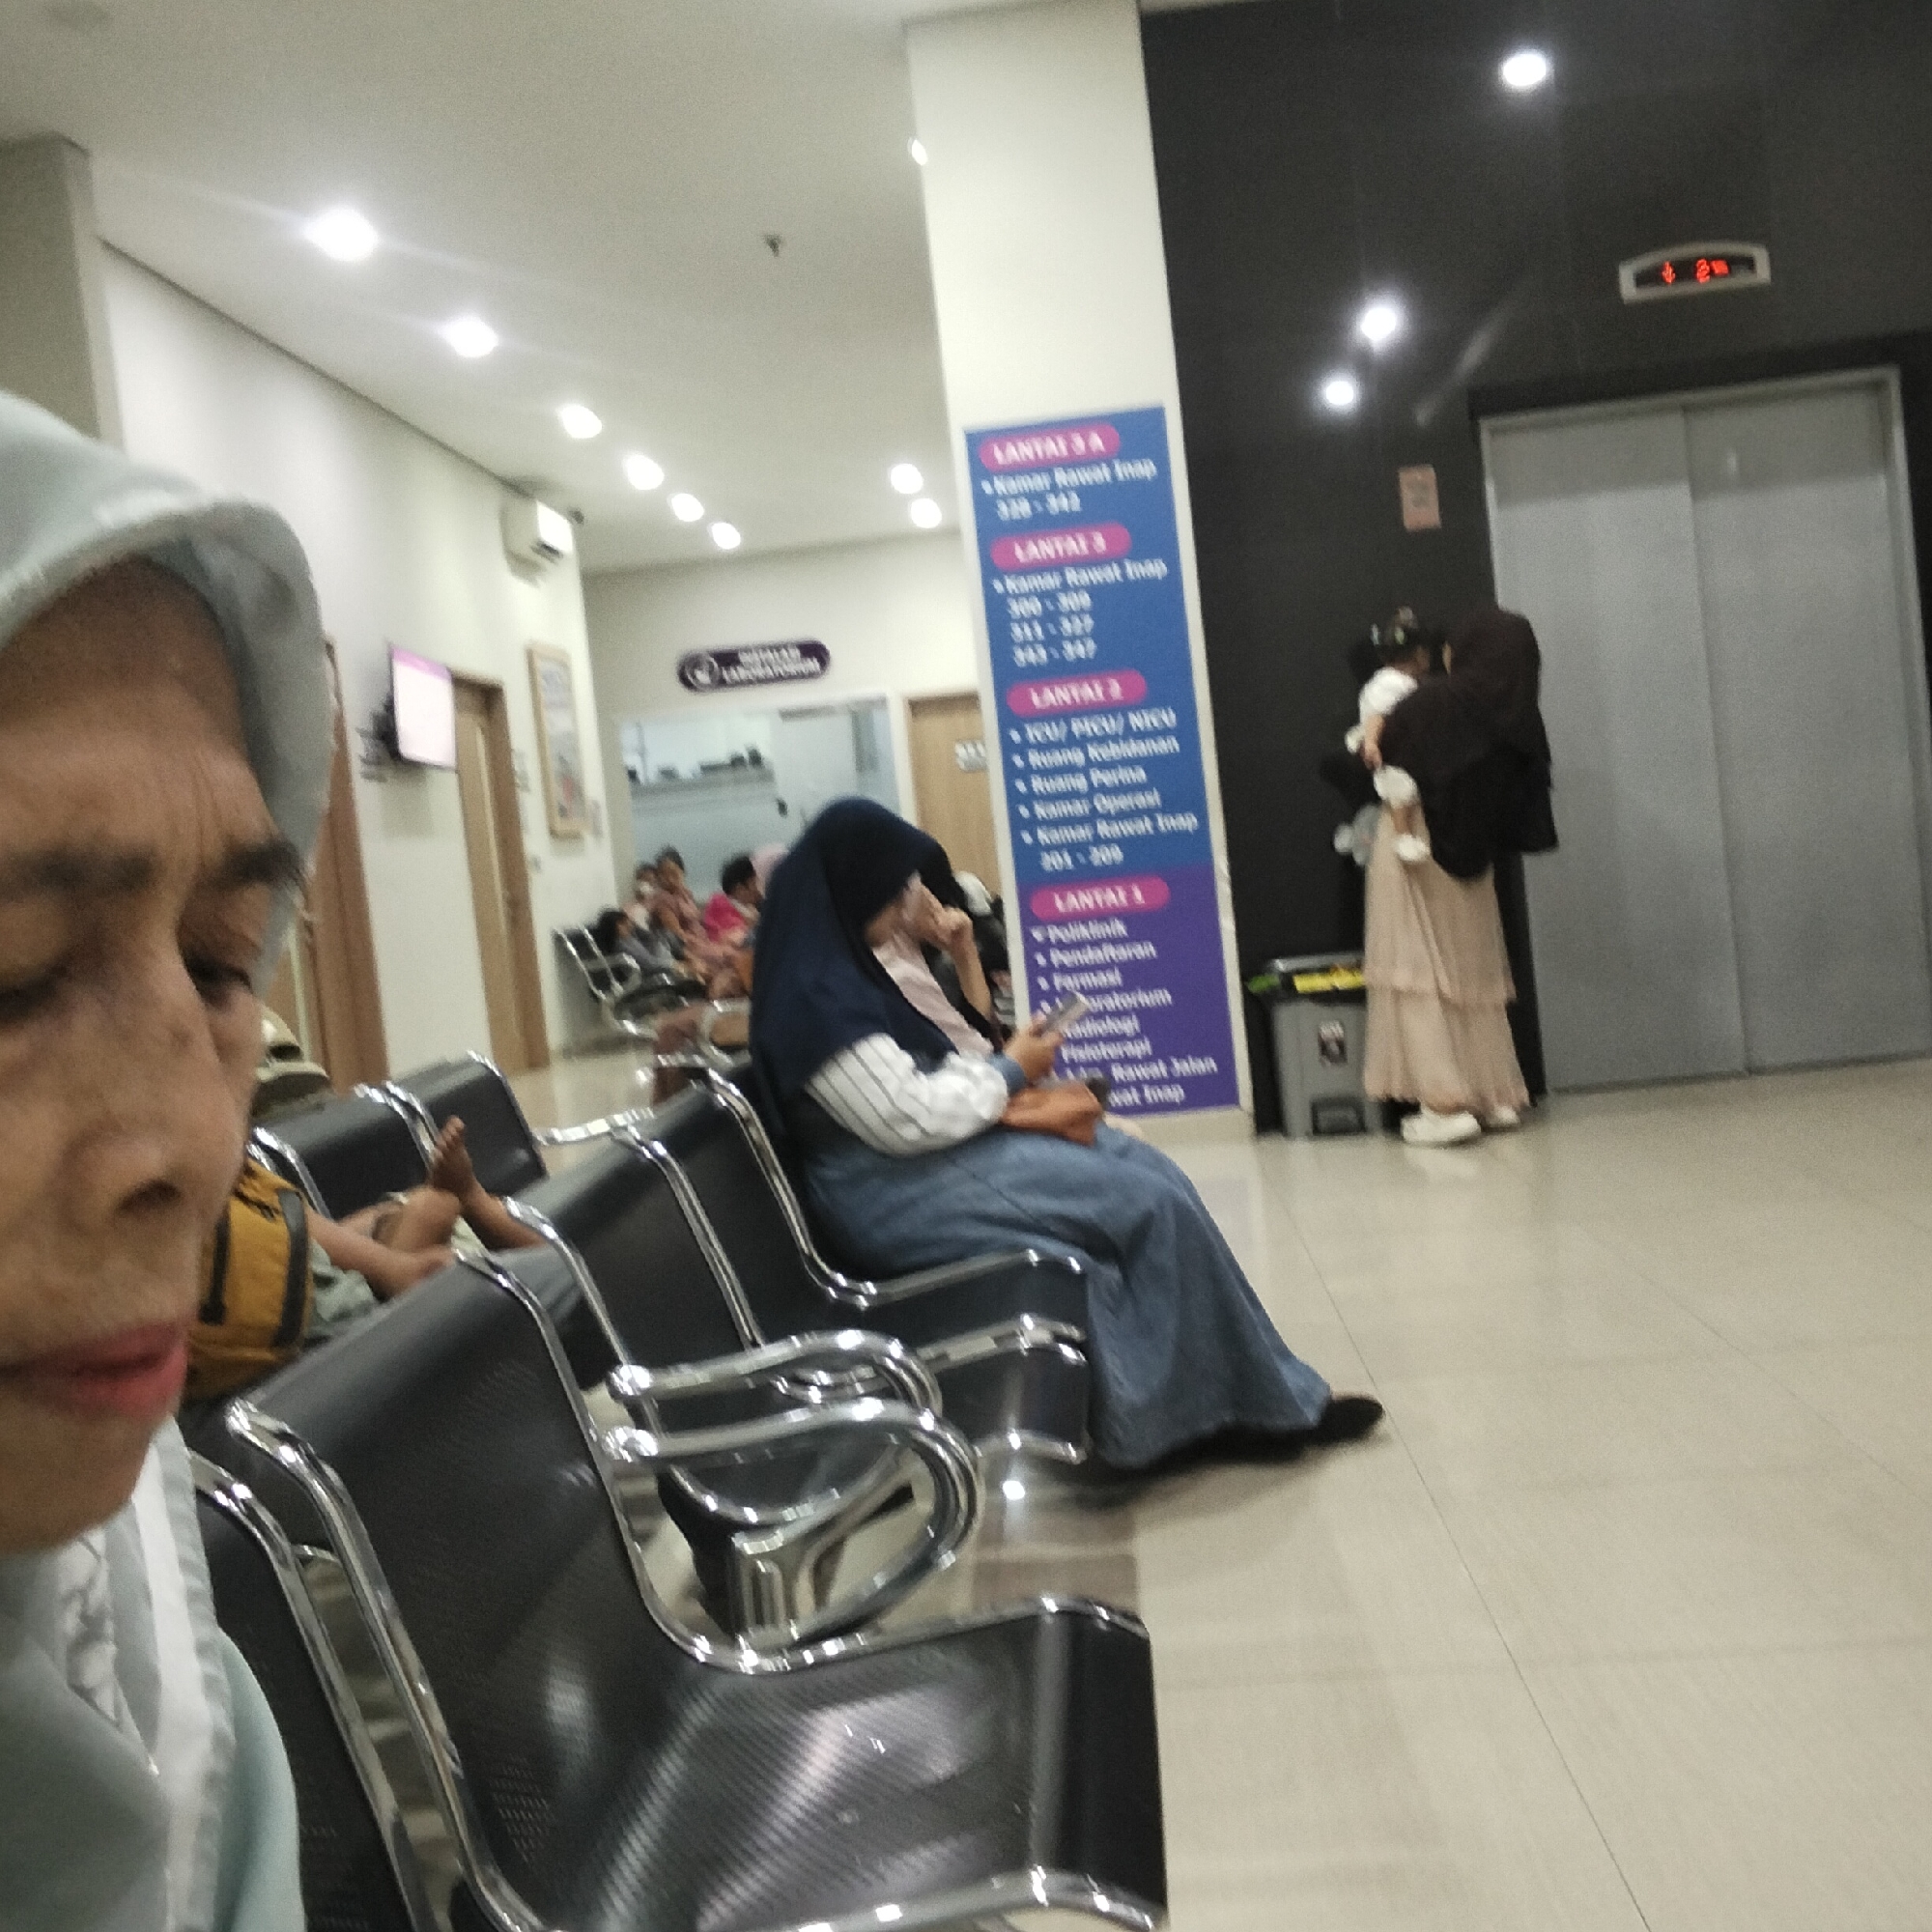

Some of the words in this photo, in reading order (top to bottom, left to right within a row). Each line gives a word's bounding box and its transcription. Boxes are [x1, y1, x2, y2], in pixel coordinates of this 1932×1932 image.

[993, 435, 1067, 465] LANTAI
[1071, 433, 1086, 455] 3
[1088, 431, 1106, 453] A
[993, 471, 1051, 495] Kamar
[1054, 463, 1112, 488] Rawat
[1114, 458, 1157, 481] Inap
[1014, 532, 1089, 563] LANTAI
[1092, 531, 1106, 554] 3
[1005, 572, 1062, 594] Kamar
[1065, 562, 1123, 587] Rawat
[1123, 558, 1168, 580] Inap
[1030, 679, 1105, 709] LANTAI
[1108, 678, 1123, 700] 2
[1127, 706, 1177, 731] NICU
[1028, 747, 1085, 770] Ruang
[1086, 735, 1180, 762] Kebidanan
[1031, 773, 1089, 795] Ruang
[1089, 765, 1147, 787] Perina
[1033, 799, 1092, 820] Kamar
[1093, 787, 1161, 814] Operasi
[1037, 823, 1094, 845] Kamar
[1096, 814, 1153, 839] Rawat
[1156, 811, 1198, 834] Inap
[1054, 885, 1128, 913] LANTAI
[1131, 883, 1145, 904] 1
[1047, 918, 1128, 945] Poliklinik
[1050, 941, 1157, 968] Pendaftaran
[1052, 967, 1123, 992] Farmasi
[1061, 1037, 1152, 1063] Fisioterapi
[1112, 1059, 1169, 1083] Rawat
[1171, 1055, 1218, 1077] Jalan
[1143, 1083, 1185, 1105] Inap
